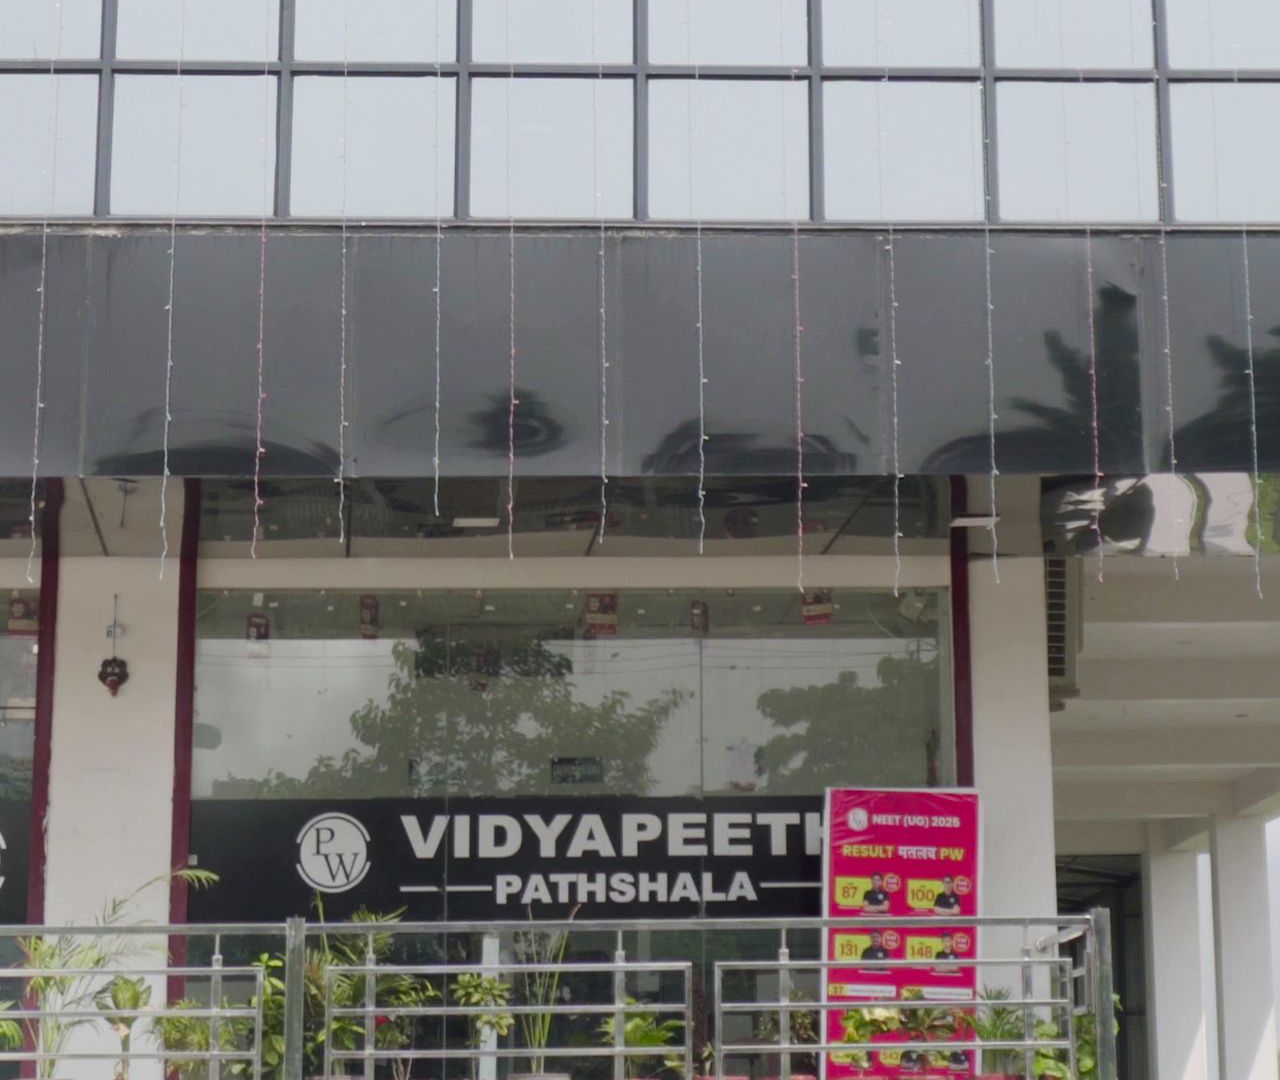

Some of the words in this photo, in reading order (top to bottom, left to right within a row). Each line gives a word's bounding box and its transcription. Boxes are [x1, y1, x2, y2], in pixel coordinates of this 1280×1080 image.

[872, 814, 901, 826] NEET
[842, 844, 895, 859] RESULT
[940, 847, 965, 861] PW
[495, 871, 758, 905] PATHSHALA
[841, 885, 859, 900] 87
[910, 888, 935, 902] 100
[840, 943, 858, 957] 131
[910, 945, 934, 959] 148
